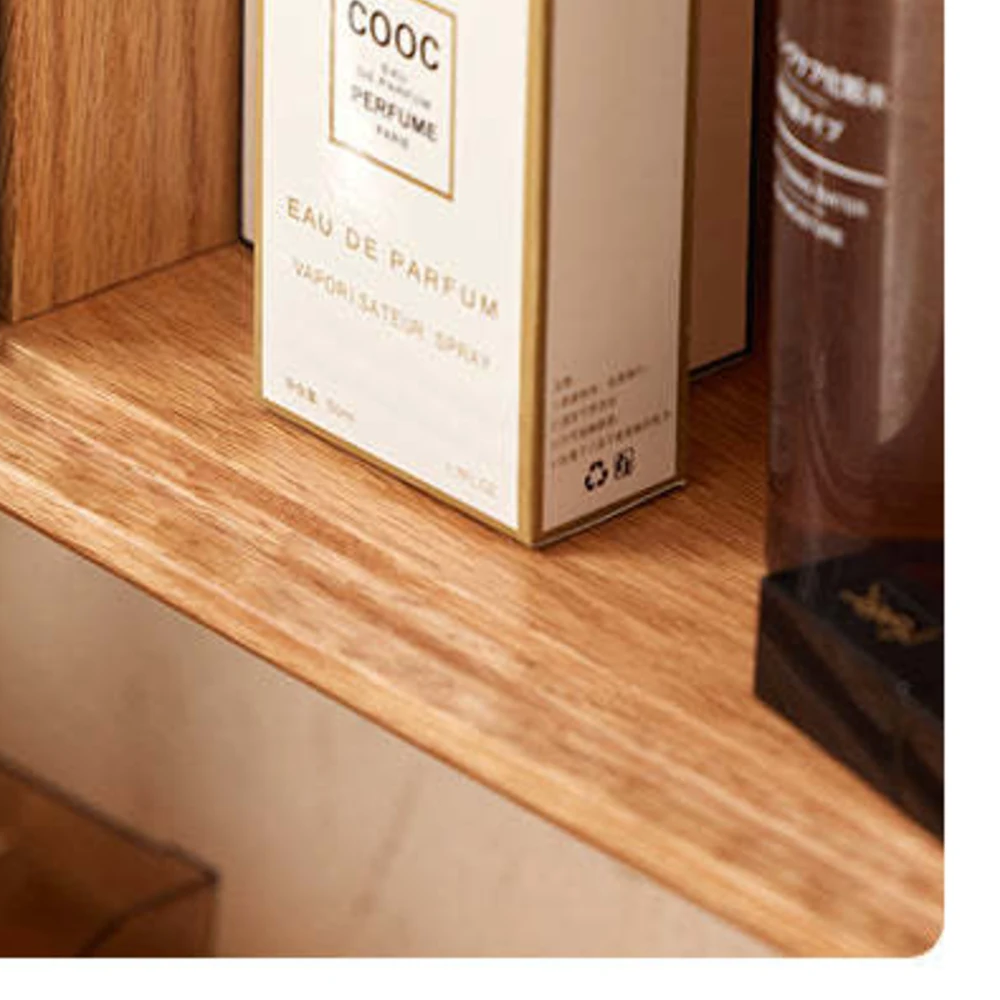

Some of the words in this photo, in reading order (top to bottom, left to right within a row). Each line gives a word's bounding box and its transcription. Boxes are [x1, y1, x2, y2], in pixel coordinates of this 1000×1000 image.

[351, 83, 438, 142] PERFUME
[286, 197, 333, 238] EAU
[345, 226, 378, 262] DE
[389, 248, 499, 320] PARFUM
